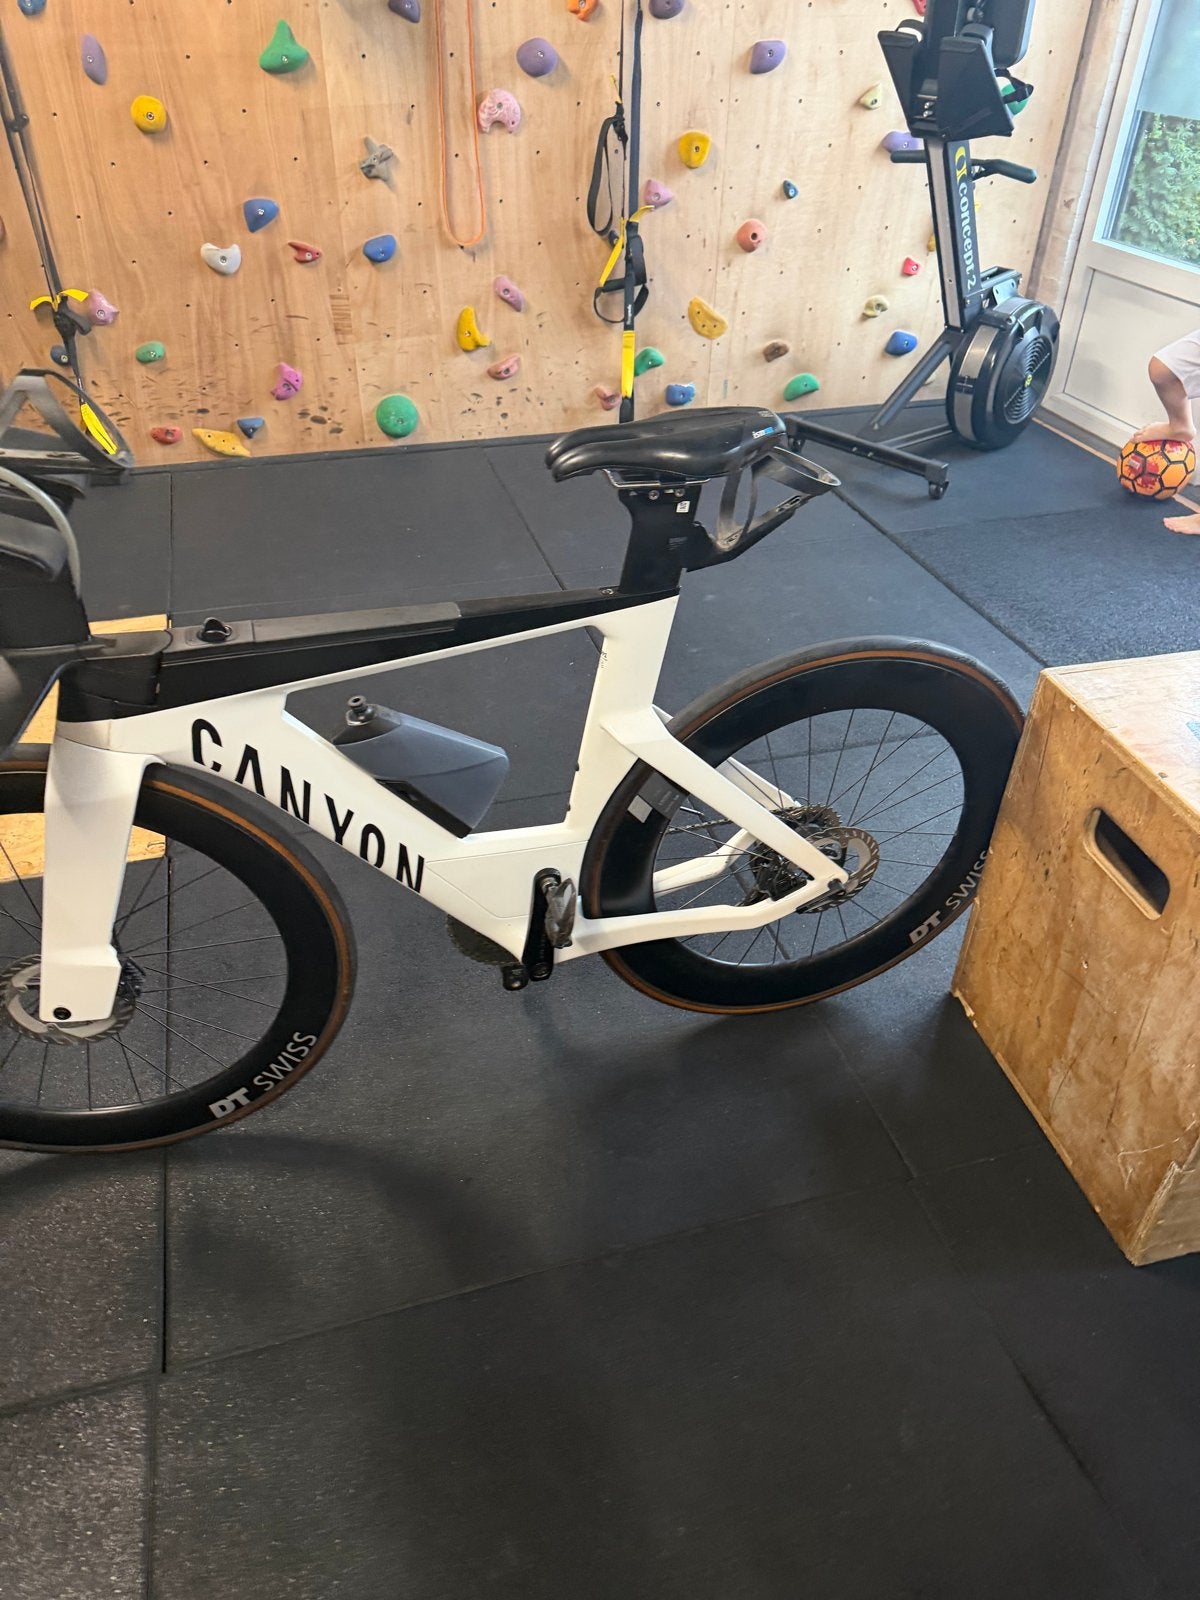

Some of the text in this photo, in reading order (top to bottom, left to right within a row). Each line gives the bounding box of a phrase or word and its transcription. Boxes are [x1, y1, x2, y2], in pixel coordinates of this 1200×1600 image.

[958, 182, 975, 275] concept
[191, 718, 425, 894] CANYON
[909, 910, 941, 944] DT
[208, 1032, 317, 1118] DT SWISS
